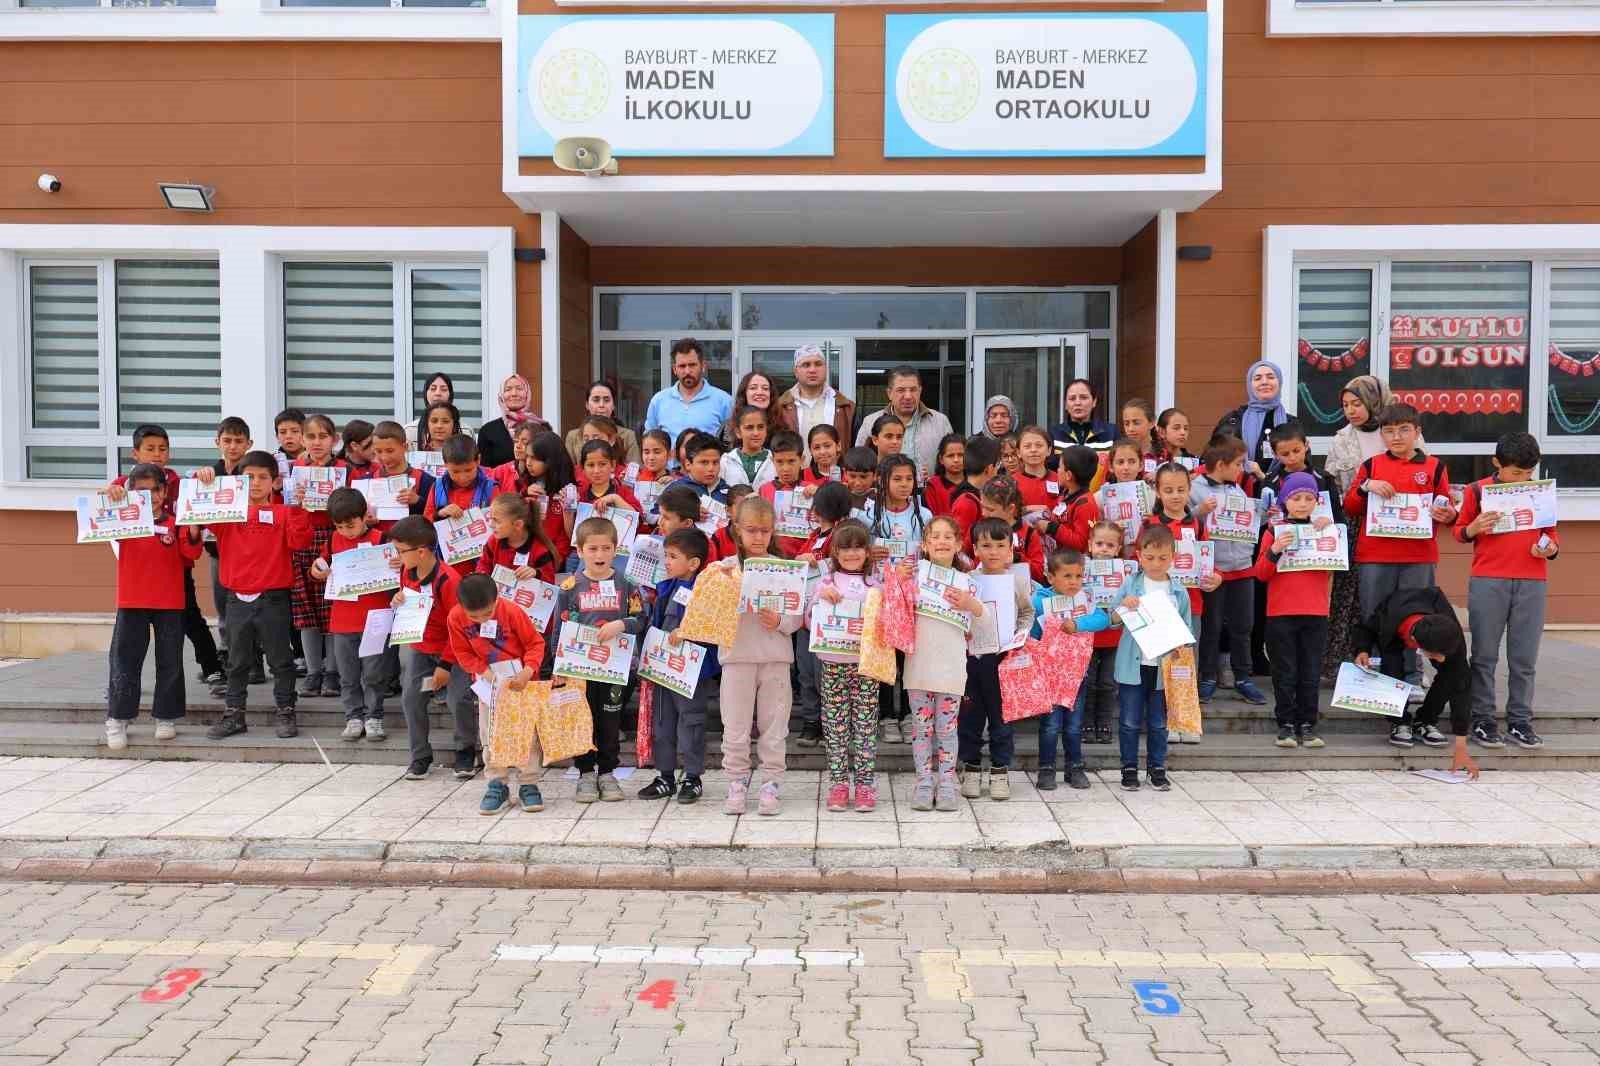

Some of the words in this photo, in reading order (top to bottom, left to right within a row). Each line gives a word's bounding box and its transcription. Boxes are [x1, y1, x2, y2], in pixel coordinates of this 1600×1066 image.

[625, 49, 697, 65] BAYBURT
[712, 49, 777, 64] MERKEZ
[995, 49, 1068, 65] BAYBURT
[1082, 49, 1148, 64] MERKEZ
[625, 70, 715, 90] MADEN
[996, 70, 1085, 89] MADEN
[625, 96, 752, 121] İLKOKULU
[995, 99, 1150, 120] ORTAOKULU
[1417, 317, 1524, 337] KUTLU
[1416, 345, 1527, 367] OLSUN
[140, 968, 204, 1003] 3
[638, 979, 677, 1009] 4
[1133, 980, 1182, 1016] 5
